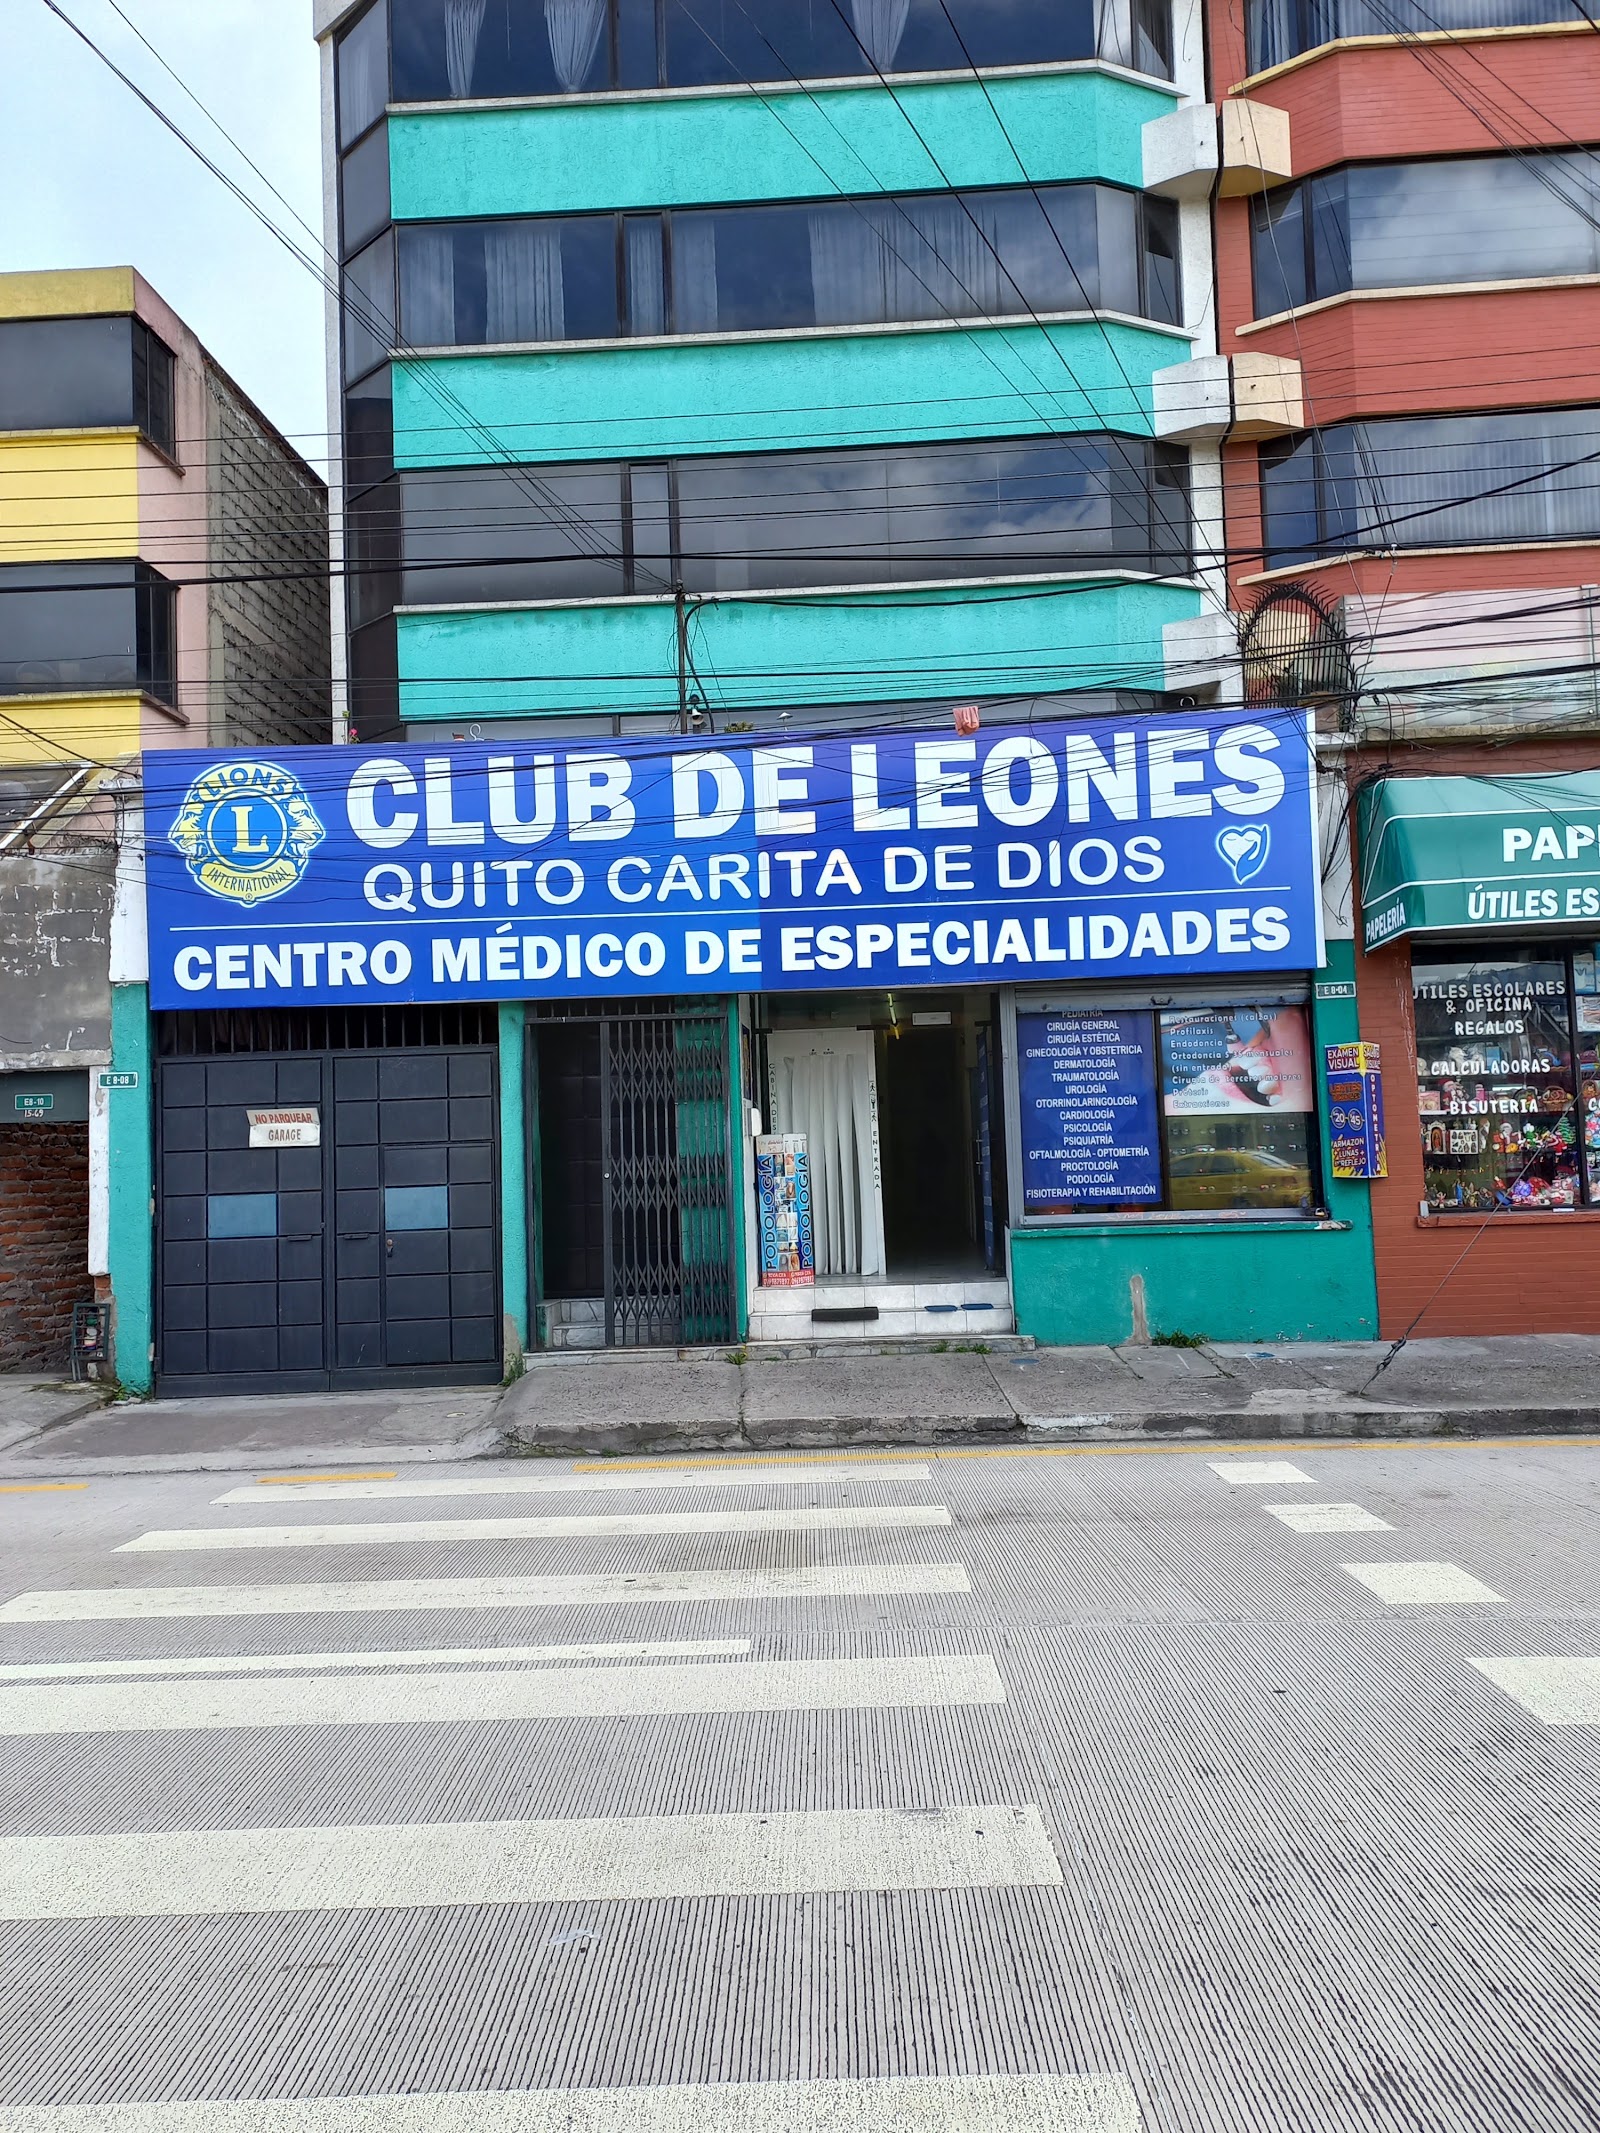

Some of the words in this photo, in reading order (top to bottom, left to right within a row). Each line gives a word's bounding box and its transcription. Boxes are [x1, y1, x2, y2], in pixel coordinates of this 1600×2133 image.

[202, 768, 289, 797] LIONS
[347, 753, 635, 849] CLUB
[672, 747, 816, 838] DE
[851, 724, 1285, 832] LEONES
[1502, 824, 1600, 863] PAP
[207, 867, 291, 892] INTERNATIONAL
[364, 860, 584, 912] QUITO
[608, 849, 862, 902] CARITA
[884, 845, 974, 892] DE
[998, 836, 1164, 888] DIOS
[1468, 884, 1559, 920] ÚTILES
[1365, 897, 1407, 944] PAPELERÍA
[173, 940, 412, 991] CENTRO
[432, 922, 666, 983] MÉDICO
[685, 930, 762, 975] DE
[780, 906, 1291, 973] ESPECIALIDADES
[1473, 981, 1566, 997] ESCOLARES
[1446, 1000, 1457, 1014] &
[1169, 1013, 1237, 1024] Restauraciones
[1047, 1020, 1080, 1031] CIRUGÍA
[1081, 1020, 1120, 1030] GENERAL
[1170, 1028, 1214, 1036] Profilaxis
[1455, 1020, 1525, 1036] REGALOS
[1047, 1033, 1080, 1044] CIRUGÍA
[1082, 1032, 1121, 1043] ESTÉTICA
[1171, 1040, 1223, 1048] Endodoncia
[1026, 1046, 1081, 1058] GINECOLOGÍA
[1083, 1046, 1088, 1055] Y
[1089, 1045, 1143, 1055] OBSTETRICIA
[1171, 1051, 1221, 1060] Ortodoncia
[1246, 1048, 1294, 1058] mensuales
[1327, 1048, 1359, 1059] EXAMEN
[1054, 1057, 1117, 1069] DERMATOLOGÍA
[1171, 1064, 1188, 1074] (sin
[1328, 1058, 1359, 1070] VISUAL
[1431, 1058, 1551, 1076] CALCULADORAS
[1052, 1070, 1120, 1082] TRAUMATOLOGÍA
[1225, 1073, 1261, 1083] terceros
[1265, 1073, 1302, 1081] molares
[769, 1063, 777, 1105] CABINA
[1065, 1083, 1107, 1094] UROLOGÍA
[1036, 1094, 1138, 1108] OTORRINOLARINGOLOGÍA
[1450, 1099, 1538, 1115] BISUTERIA
[254, 1114, 268, 1124] NO
[269, 1112, 313, 1124] PARQUEAR
[1060, 1108, 1115, 1120] CARDIOLOGÍA
[1063, 1121, 1112, 1133] PSICOLOGÍA
[268, 1129, 302, 1142] GARAGE
[1063, 1134, 1114, 1146] PSIQUIATRÍA
[1332, 1138, 1365, 1148] ARMAZON
[1029, 1147, 1091, 1160] OFTALMOLOGÍA
[1097, 1145, 1149, 1157] OPTOMETRÍA
[1339, 1148, 1359, 1158] LUNAS
[872, 1130, 881, 1189] ENTRADA
[1061, 1159, 1119, 1171] PROCTOLOGÍA
[1066, 1172, 1114, 1184] PODOLOGÍA
[1026, 1188, 1081, 1198] FISIOTERAPIA
[1083, 1187, 1088, 1196] Y
[1089, 1184, 1156, 1196] REHABILITACIÓN
[758, 1156, 777, 1269] PODOLOGÍA
[796, 1154, 813, 1268] PODOLOGÍA
